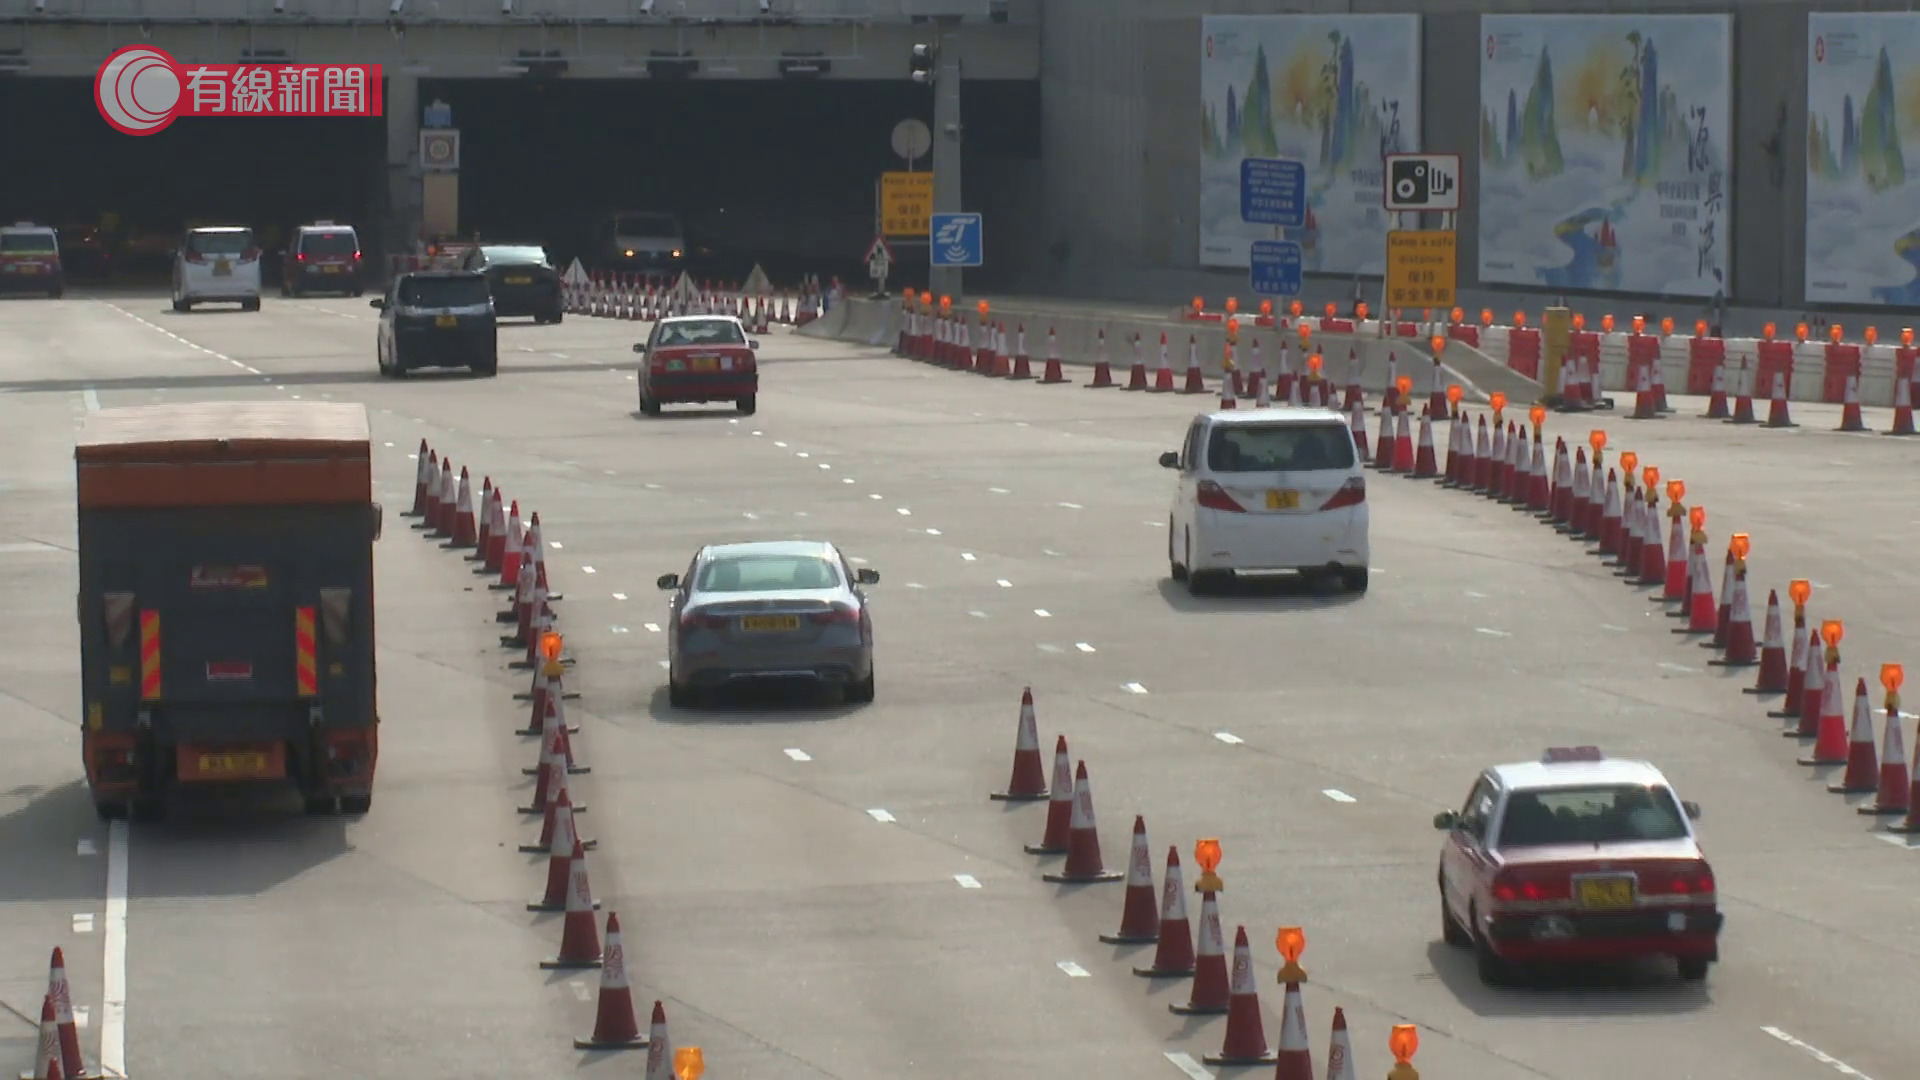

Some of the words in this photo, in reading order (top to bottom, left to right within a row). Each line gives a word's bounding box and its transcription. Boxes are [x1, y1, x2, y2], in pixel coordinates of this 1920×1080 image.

[1391, 237, 1417, 247] Keep
[1431, 236, 1454, 247] safe
[1398, 255, 1445, 264] distance
[1407, 270, 1435, 284] 保持
[1392, 287, 1451, 302] 安全車距
